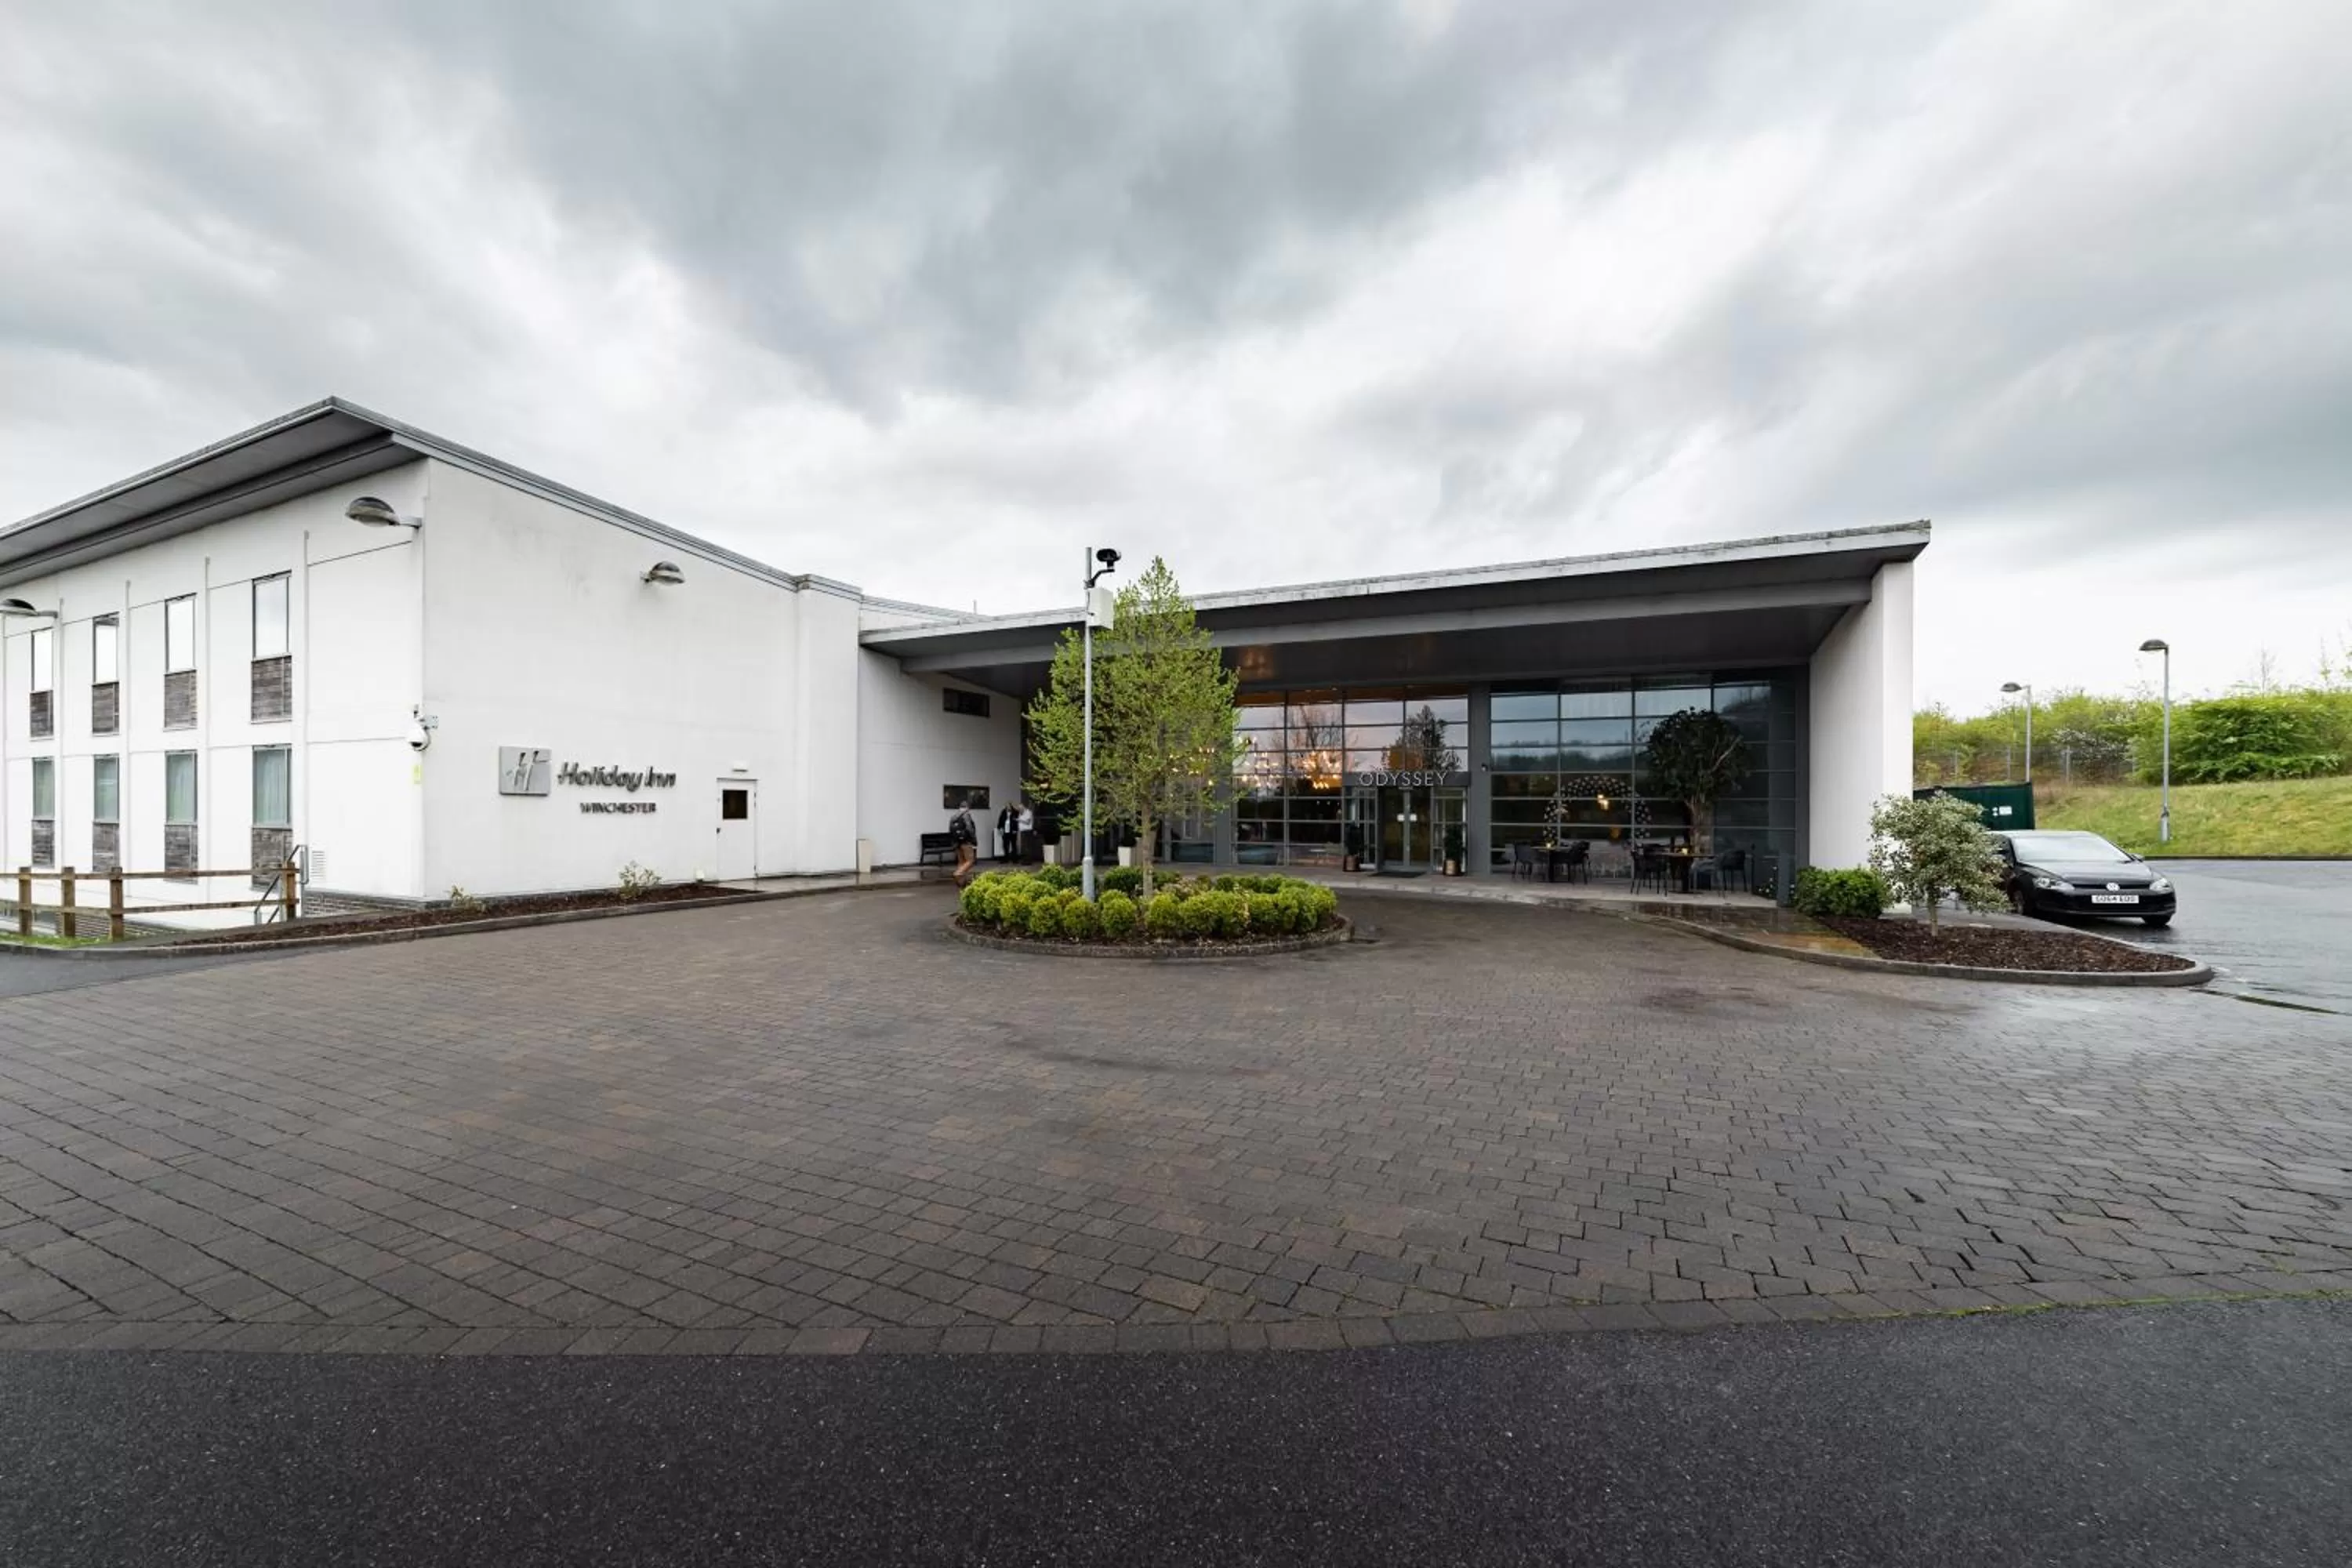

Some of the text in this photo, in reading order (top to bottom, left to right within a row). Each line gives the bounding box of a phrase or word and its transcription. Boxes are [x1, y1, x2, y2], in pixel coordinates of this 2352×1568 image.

[557, 761, 676, 792] Holiday Inn
[1359, 771, 1447, 786] ODYSSEY
[579, 802, 656, 814] WINCHESTER
